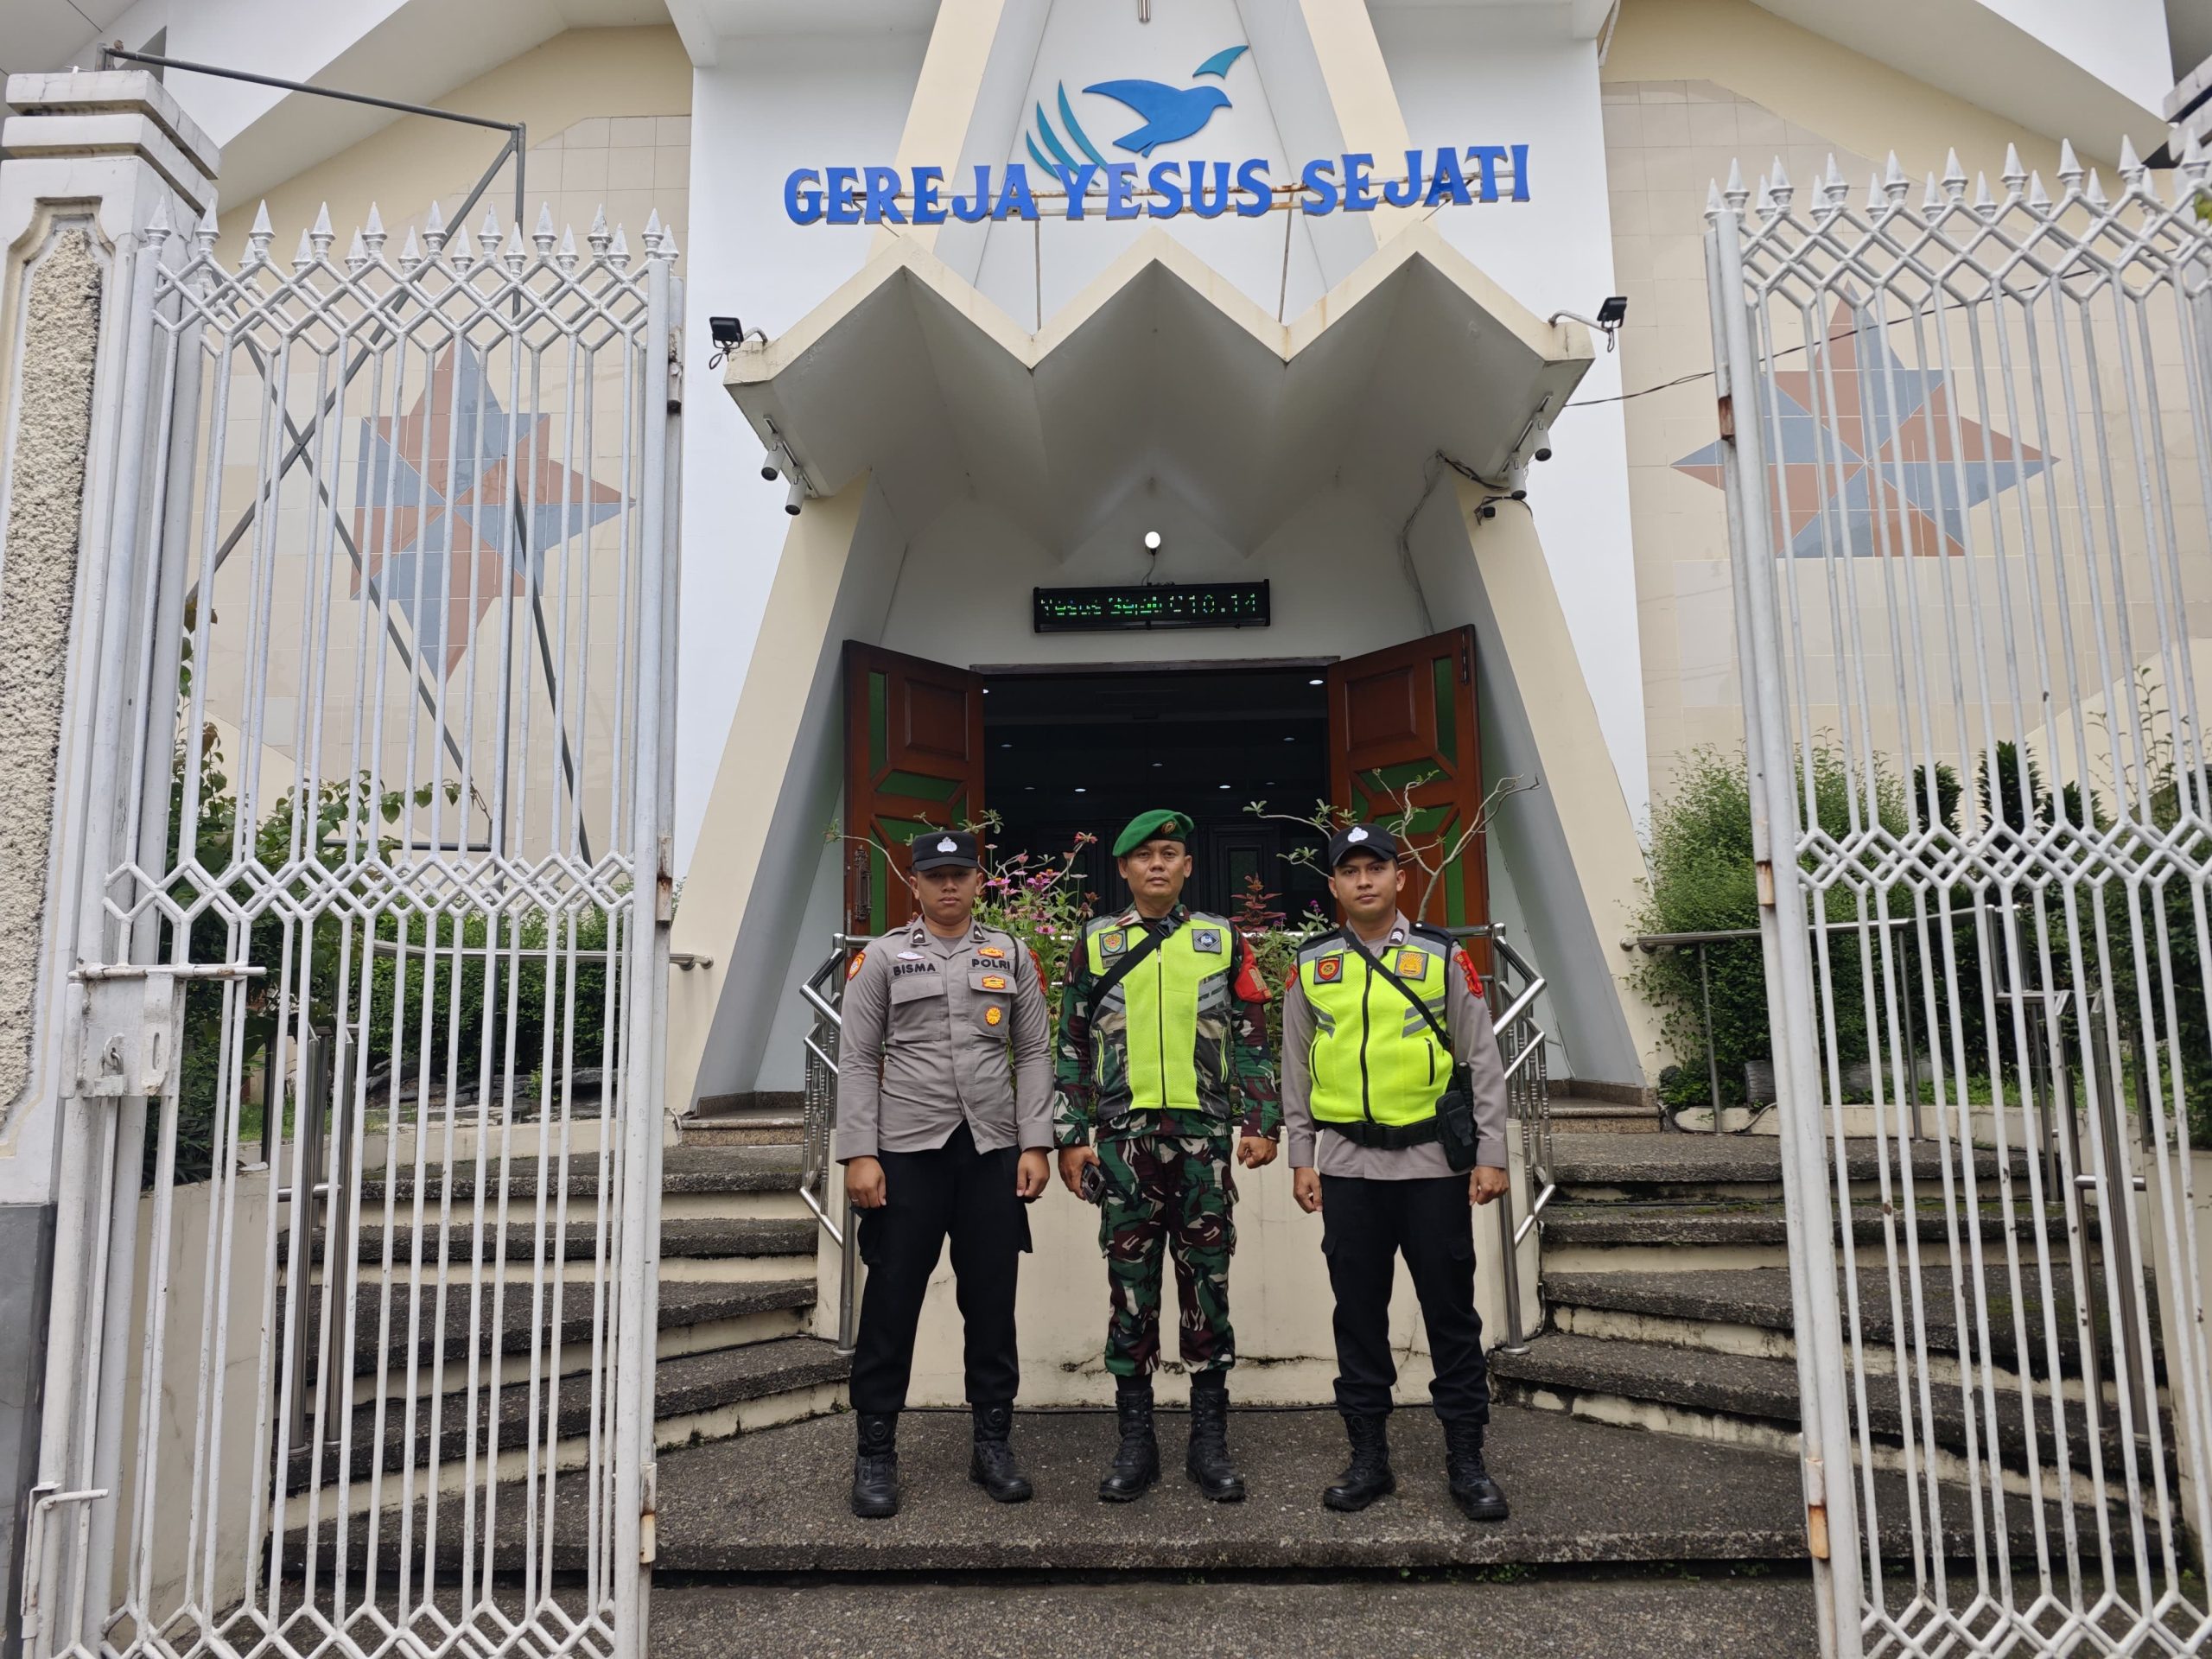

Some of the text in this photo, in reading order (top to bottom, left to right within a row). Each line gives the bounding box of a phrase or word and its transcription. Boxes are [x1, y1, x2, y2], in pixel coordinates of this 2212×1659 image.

[784, 144, 1531, 226] GEREJA YESUS SEJATI
[893, 963, 937, 976] BISMA
[971, 958, 1011, 970] POLRI
